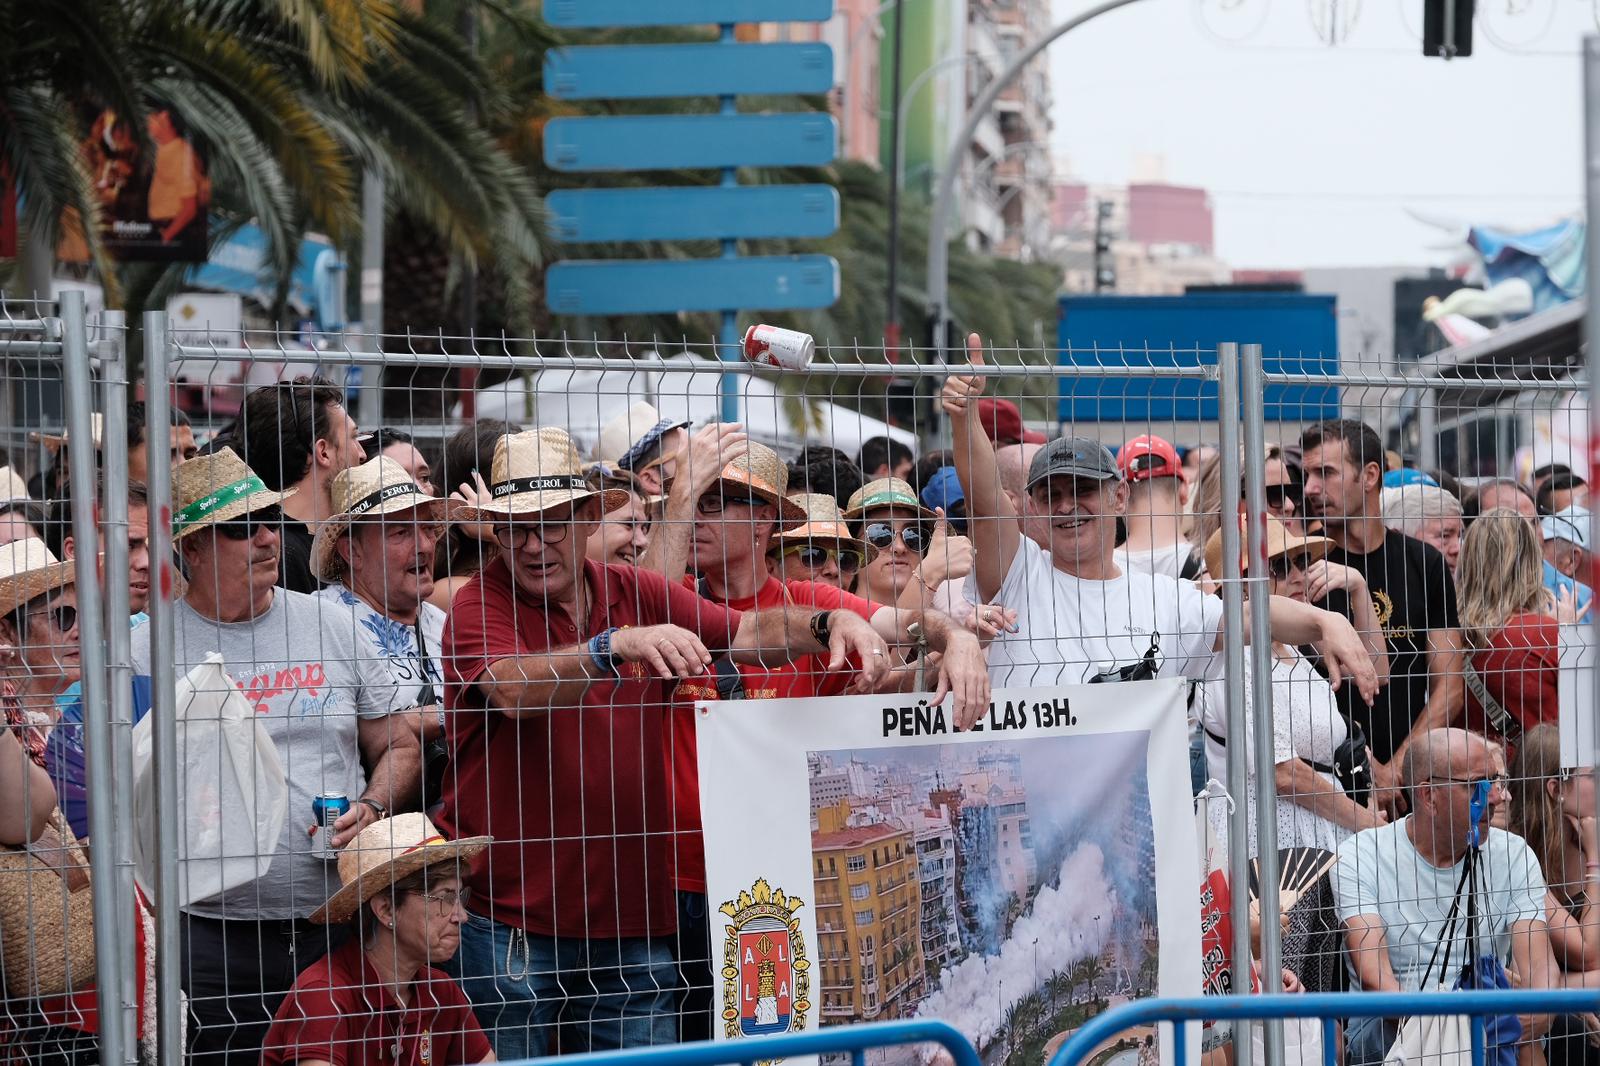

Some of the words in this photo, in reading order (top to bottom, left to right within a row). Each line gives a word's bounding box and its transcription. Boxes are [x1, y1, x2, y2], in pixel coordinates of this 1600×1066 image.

[494, 483, 518, 496] CEROL
[529, 478, 563, 489] CEROL
[882, 700, 947, 737] PEÑA
[990, 700, 1027, 731] LAS
[1032, 698, 1077, 728] 13H.
